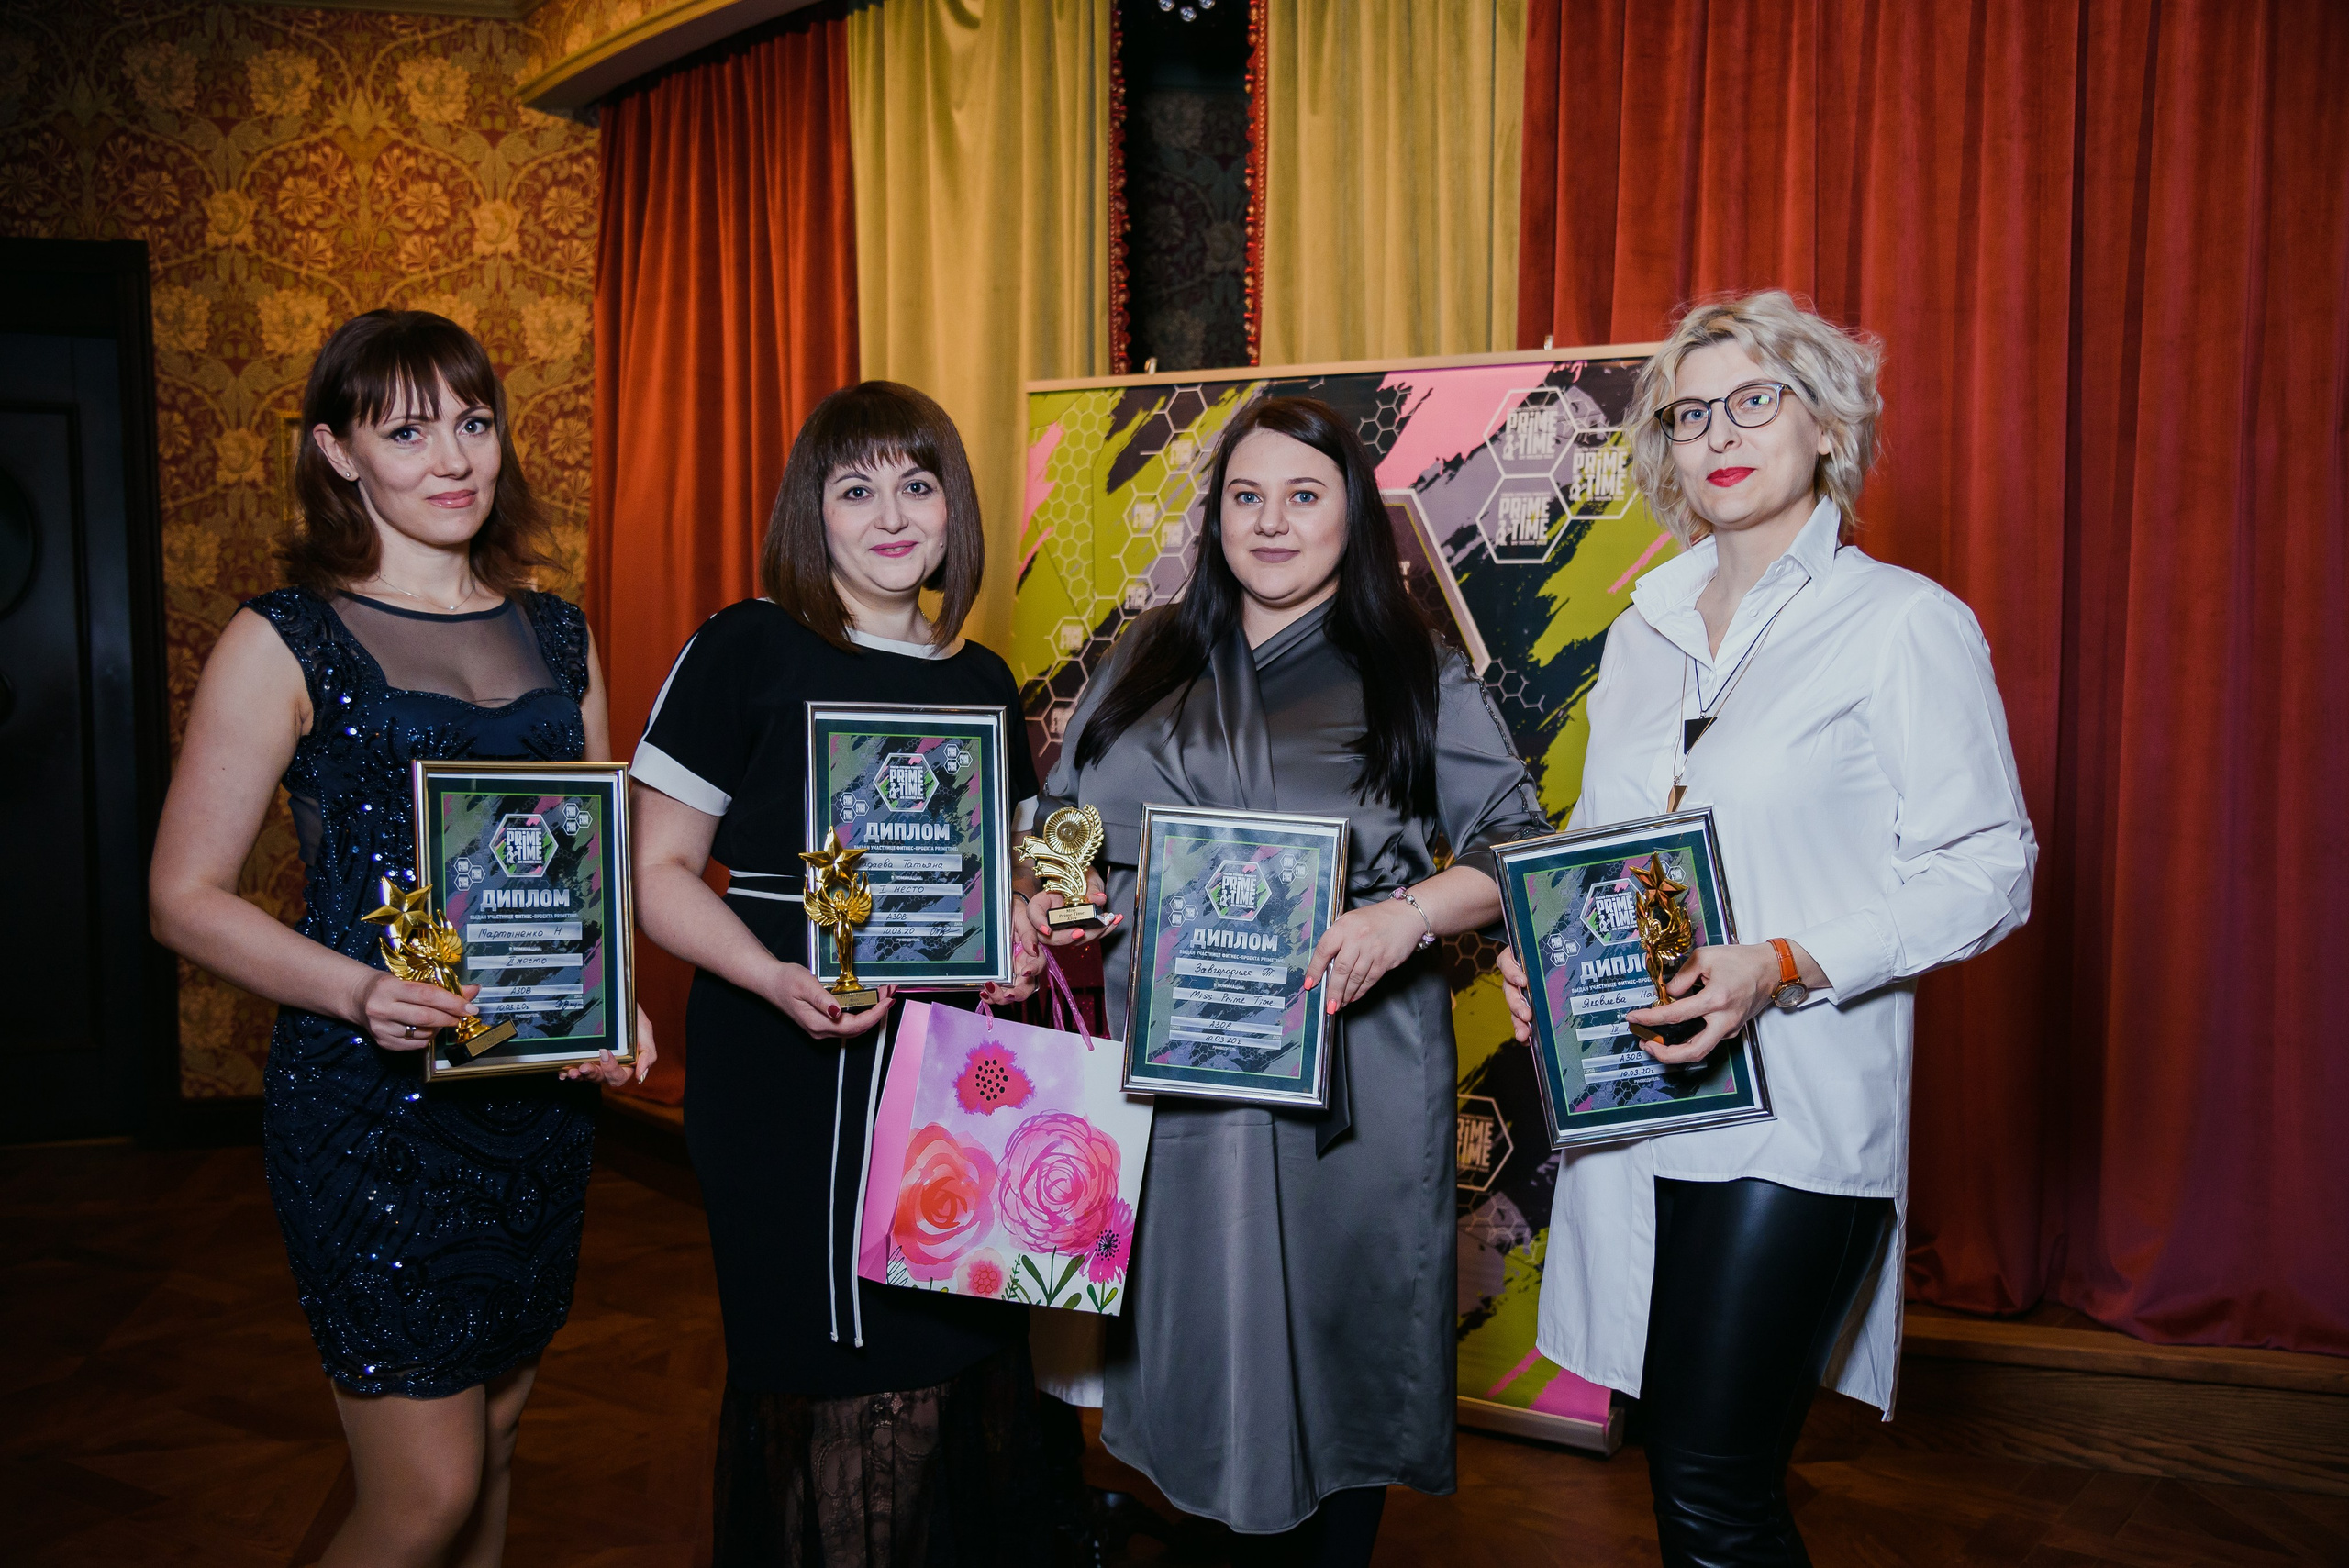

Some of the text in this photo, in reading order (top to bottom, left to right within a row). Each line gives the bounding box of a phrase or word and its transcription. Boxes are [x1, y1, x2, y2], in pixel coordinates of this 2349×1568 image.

[863, 822, 951, 843] ДИПЛОМ
[904, 859, 943, 869] Татьяна
[480, 889, 571, 912] ДИПЛОМ
[1190, 928, 1279, 952] ДИПЛОМ
[1580, 951, 1648, 984] ДИПЛ
[1189, 991, 1275, 1006] Miss Prime Time
[1620, 1051, 1643, 1062] АЗОВ
